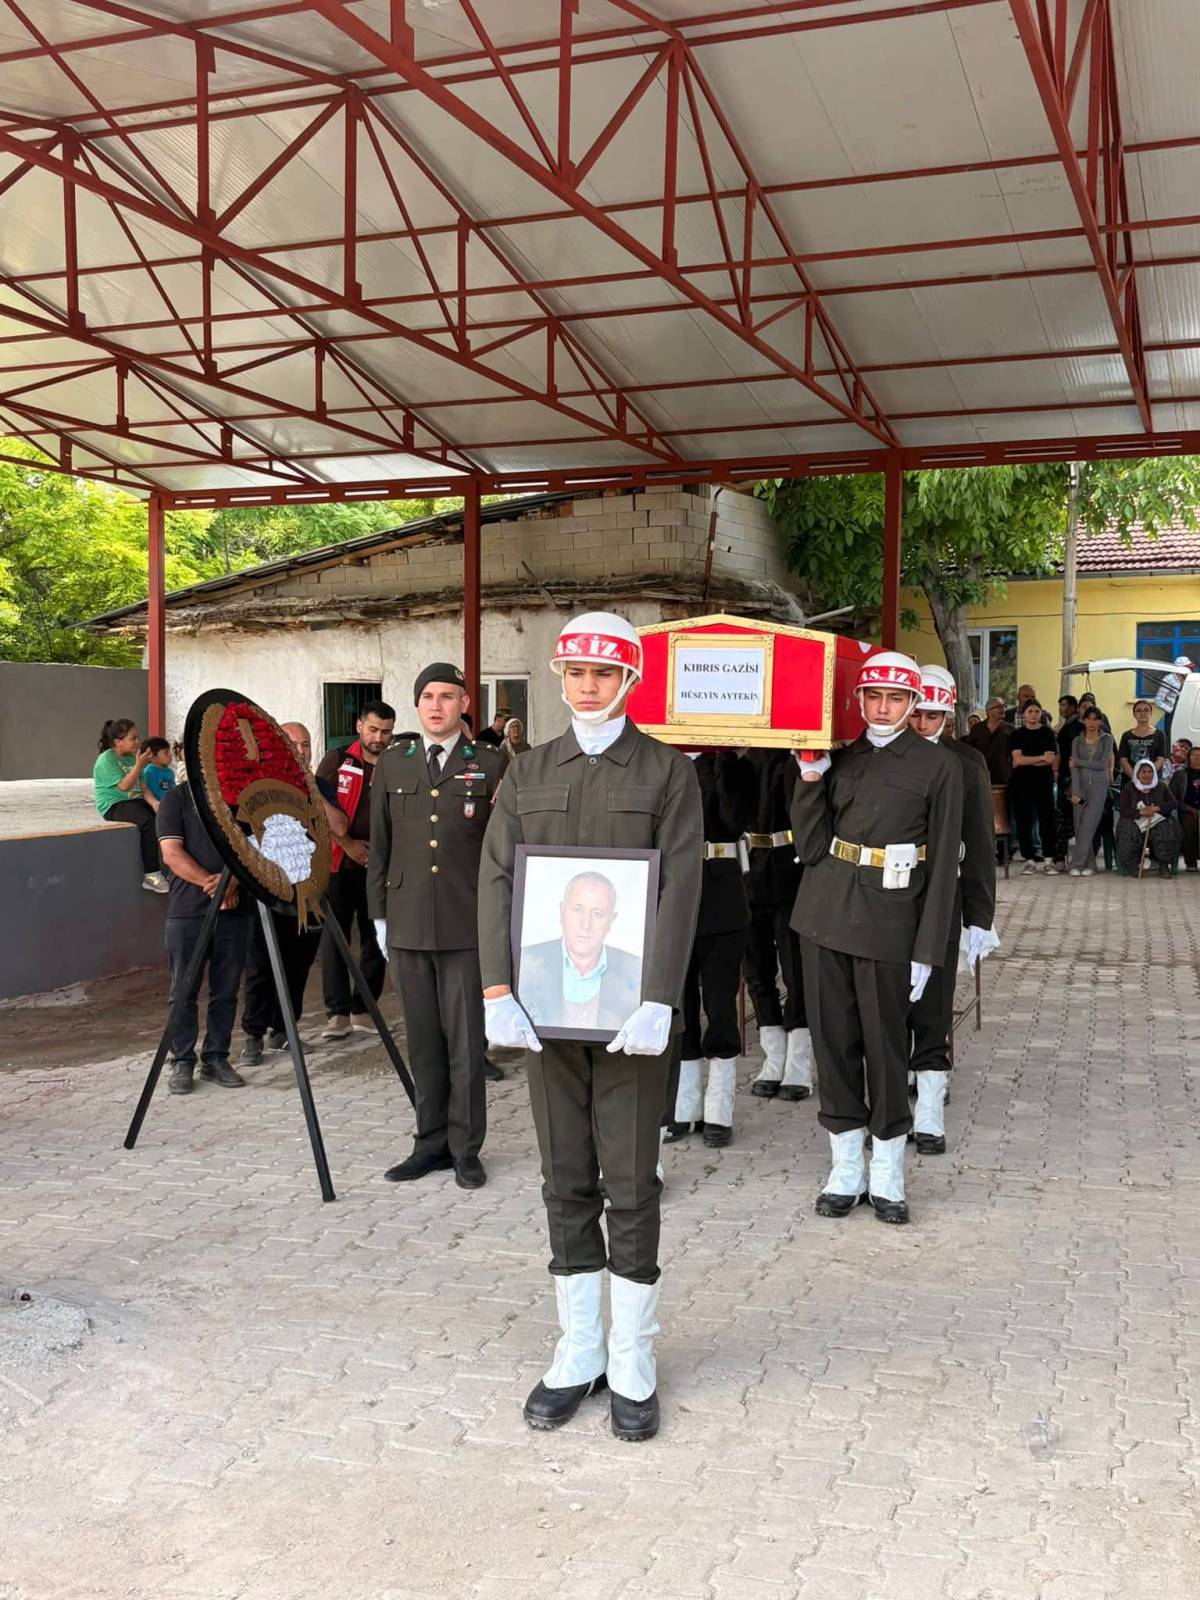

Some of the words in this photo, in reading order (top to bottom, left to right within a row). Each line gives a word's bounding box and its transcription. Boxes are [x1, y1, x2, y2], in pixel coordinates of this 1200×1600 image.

[588, 635, 621, 659] İZ.
[684, 663, 720, 673] KIBRIS
[722, 662, 759, 673] GAZİSİ
[681, 690, 719, 699] HÜSEYİN
[720, 691, 760, 700] AYTEKİN
